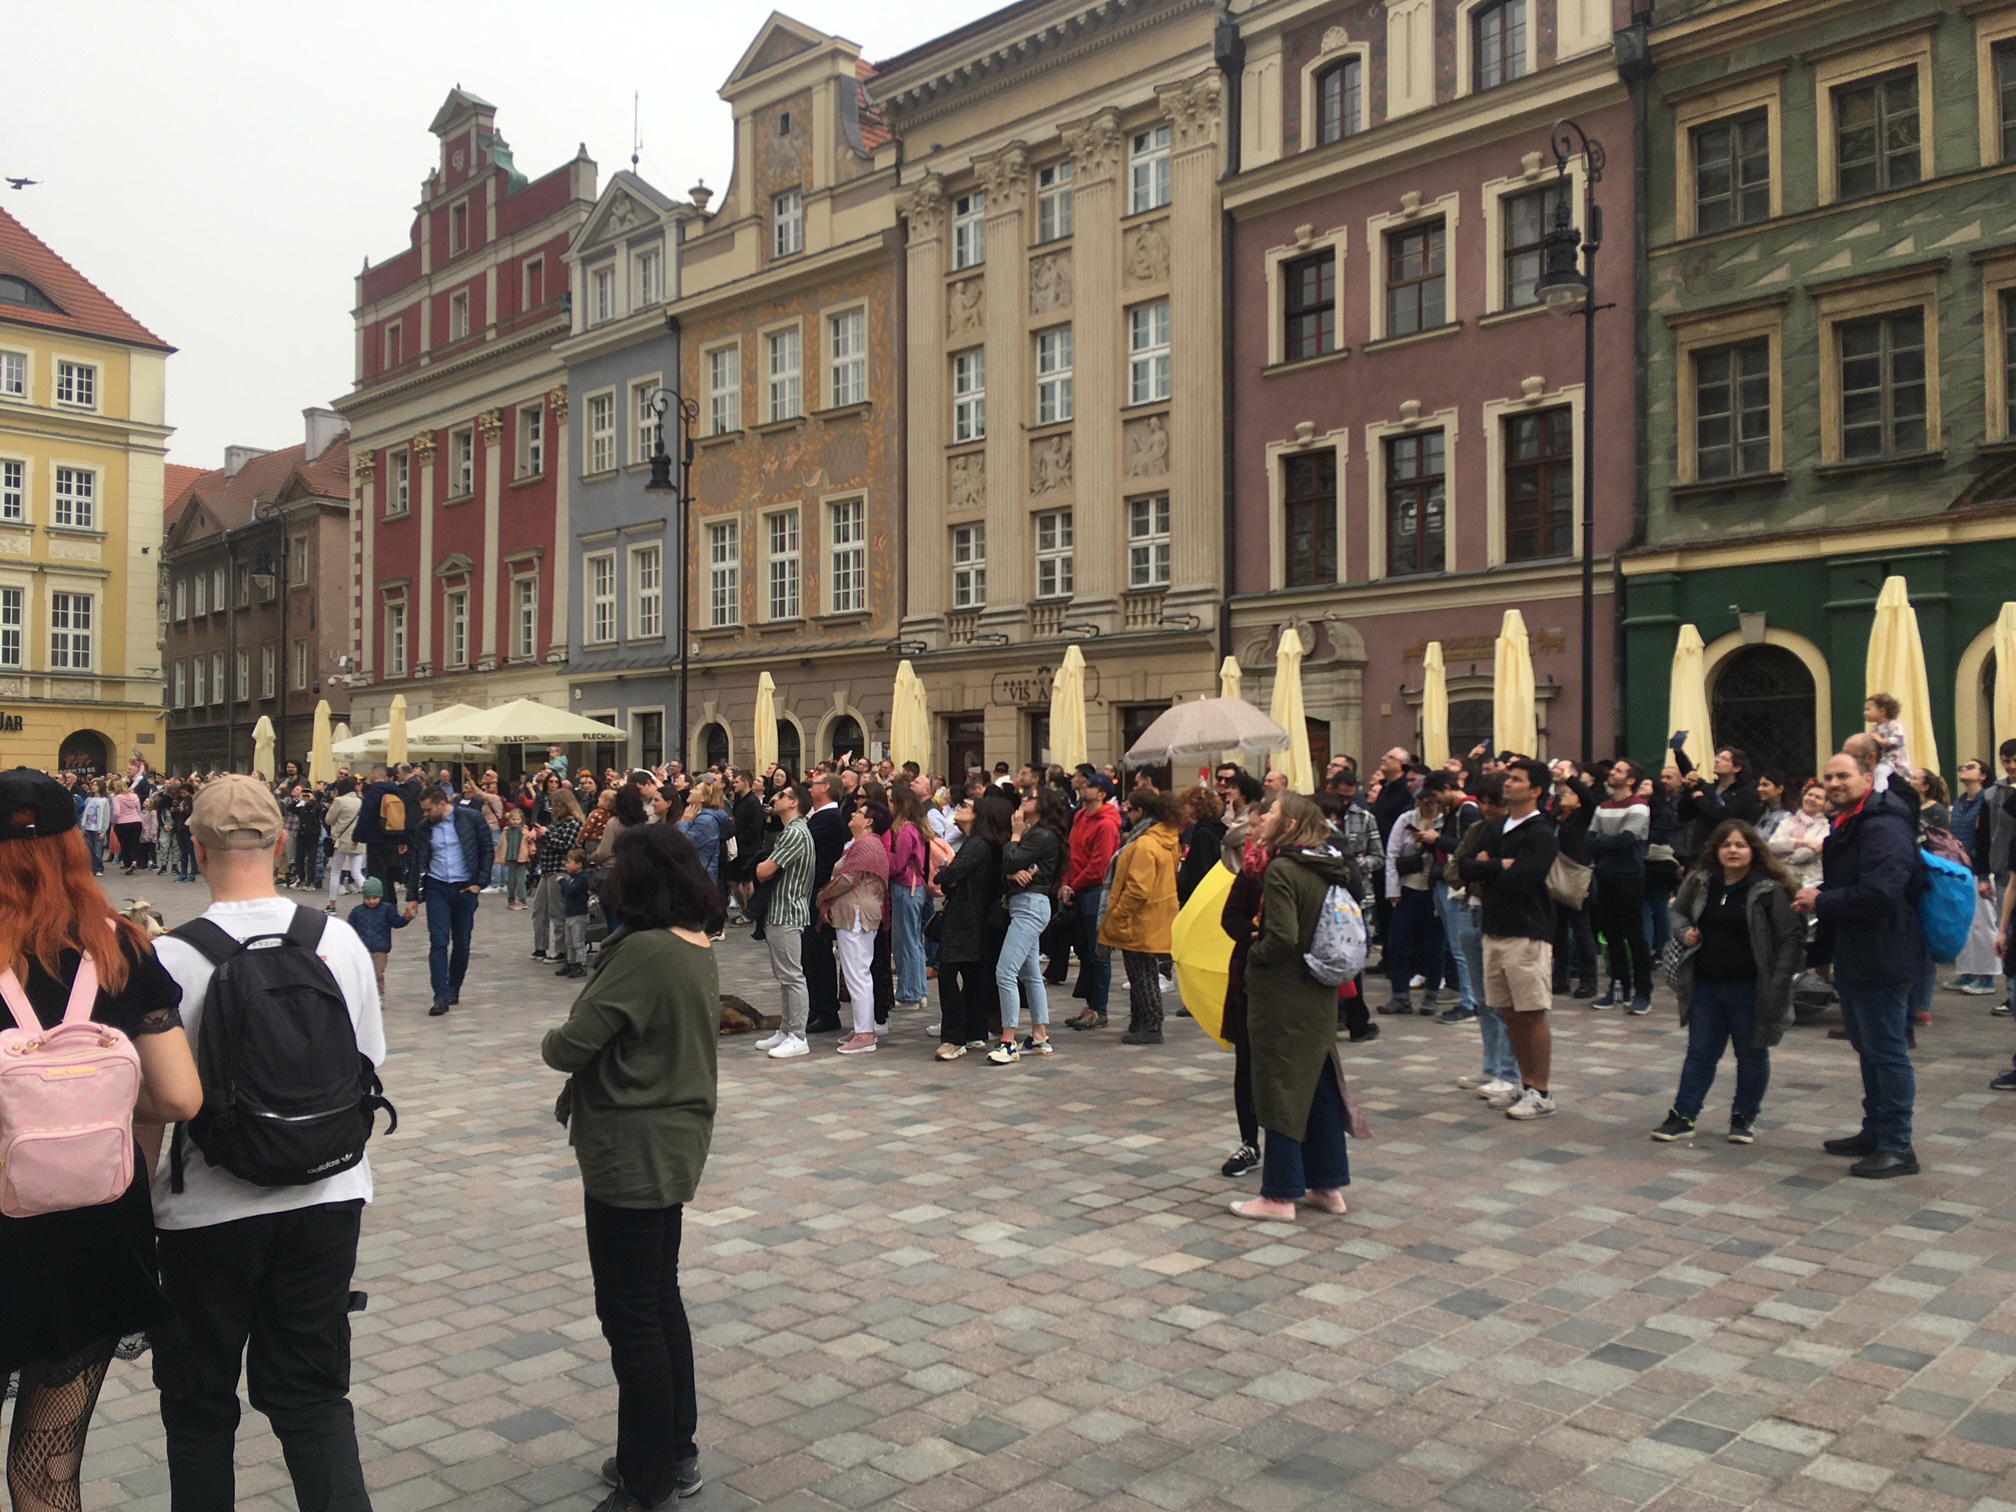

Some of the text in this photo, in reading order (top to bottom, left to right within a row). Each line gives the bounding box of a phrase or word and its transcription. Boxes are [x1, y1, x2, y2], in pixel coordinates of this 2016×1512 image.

[1009, 686, 1049, 701] VIS A
[0, 711, 23, 731] JAR
[508, 735, 530, 743] LECH
[307, 1159, 340, 1174] adidas
